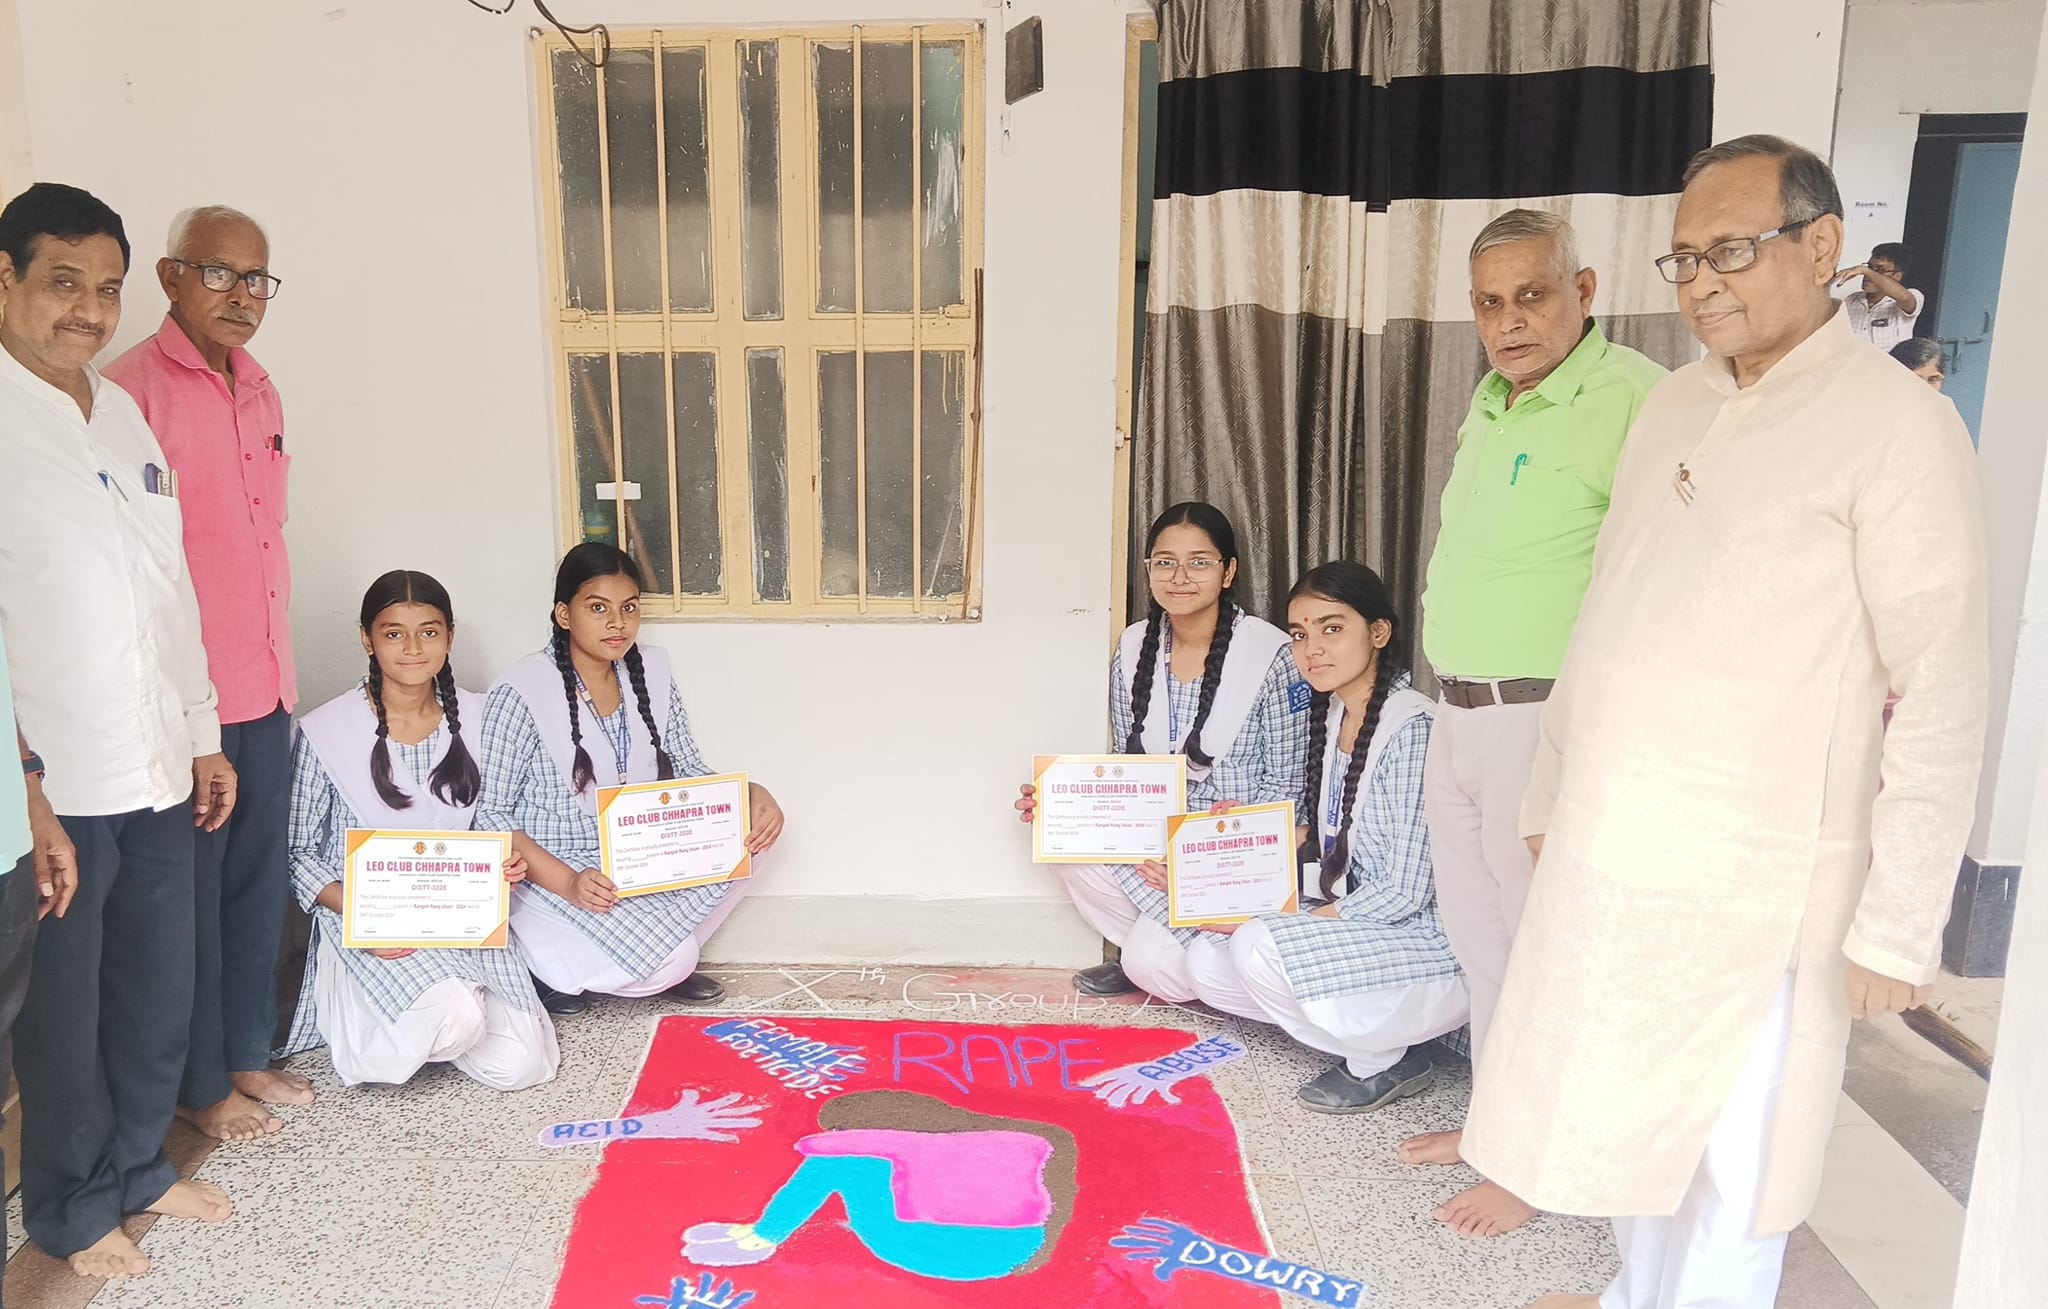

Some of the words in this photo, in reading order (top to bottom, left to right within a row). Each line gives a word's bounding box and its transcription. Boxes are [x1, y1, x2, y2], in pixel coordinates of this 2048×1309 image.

[1052, 784, 1068, 793] LEO
[1070, 784, 1092, 794] CLUB
[1095, 784, 1137, 794] CHHAPRA
[1140, 784, 1166, 794] TOWN
[618, 816, 634, 826] LEO
[637, 813, 659, 824] CLUB
[663, 807, 703, 822] CHHAPRA
[706, 803, 731, 815] TOWN
[1182, 844, 1196, 854] LEO
[1197, 840, 1216, 852] CLUB
[1218, 836, 1253, 850] CHHAPRA
[1256, 834, 1278, 846] TOWN
[367, 861, 384, 871] LEO
[387, 862, 412, 872] CLUB
[415, 862, 460, 872] CHHAPRA
[464, 863, 491, 872] TOWN
[735, 1018, 867, 1076] FEMALE
[892, 1031, 1099, 1094] RAPE
[1138, 1037, 1241, 1081] ABUSE
[716, 1032, 844, 1100] FOETICIDE
[552, 1118, 644, 1139] ACID
[1179, 1240, 1360, 1302] DOWRY
